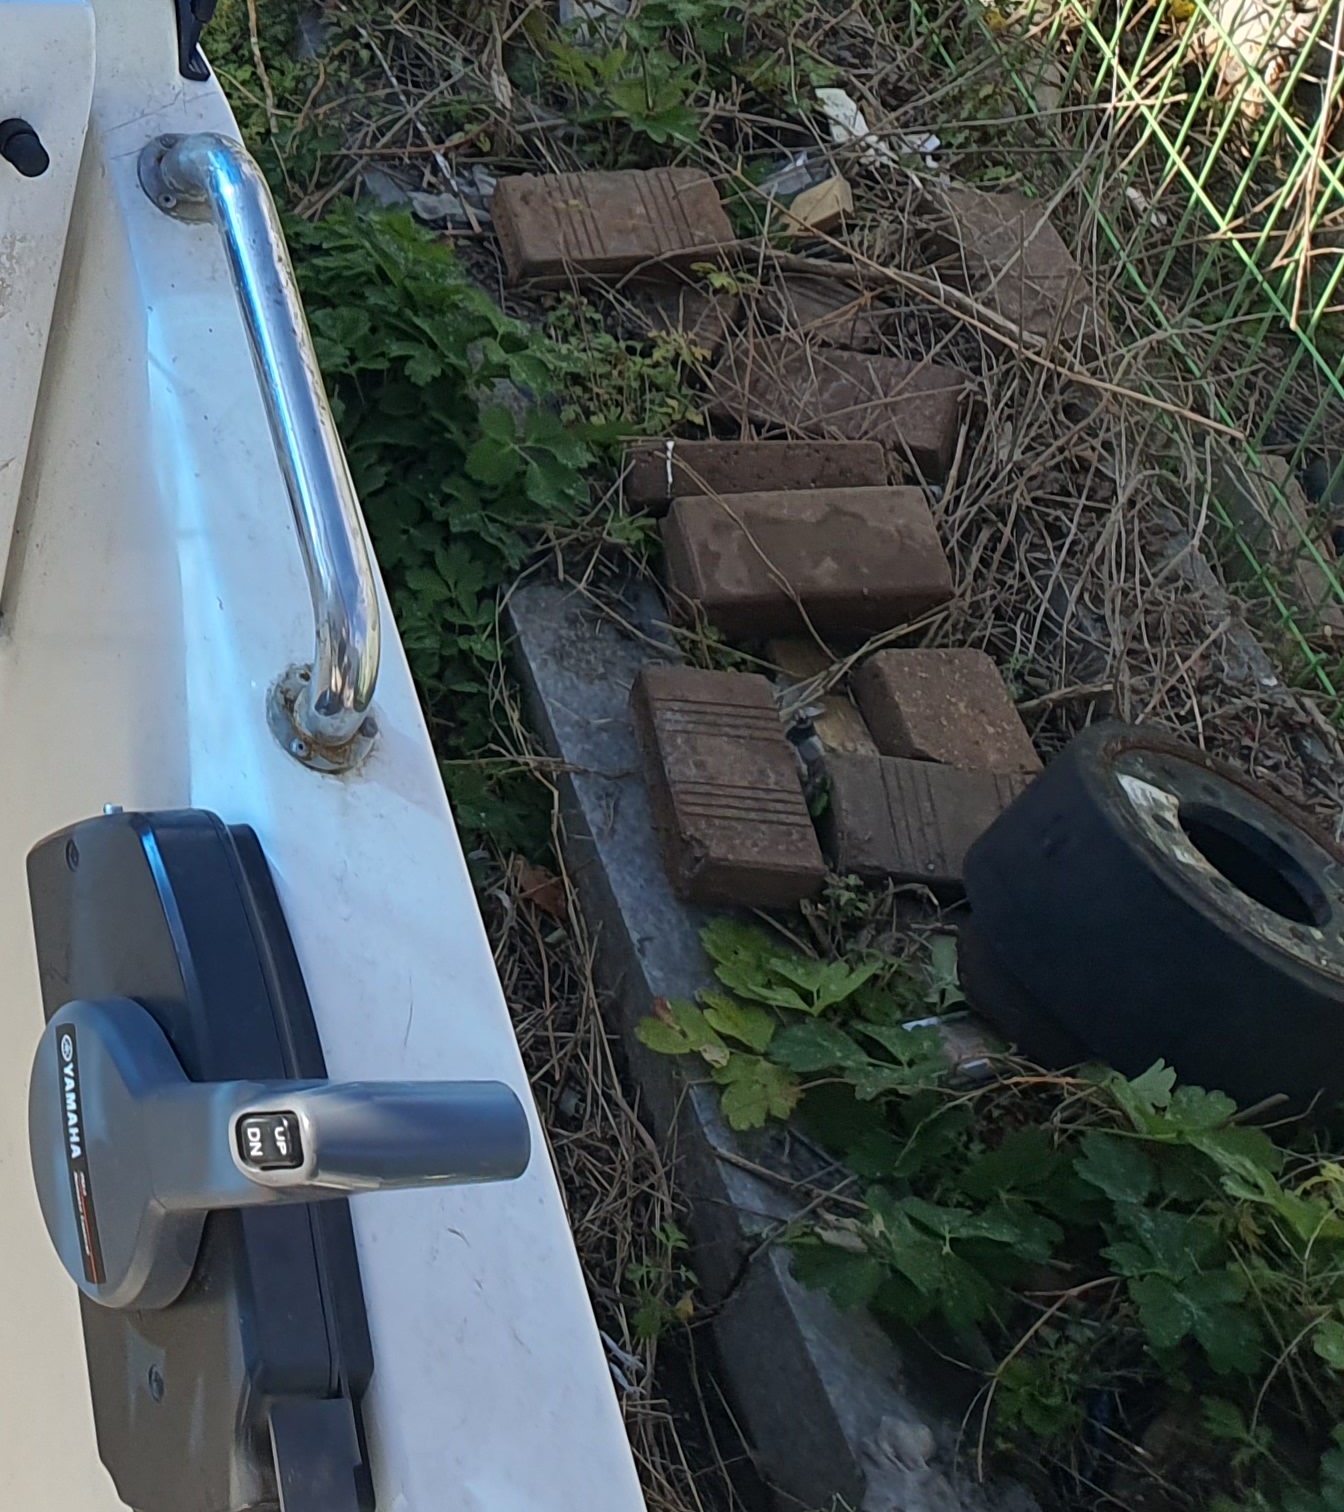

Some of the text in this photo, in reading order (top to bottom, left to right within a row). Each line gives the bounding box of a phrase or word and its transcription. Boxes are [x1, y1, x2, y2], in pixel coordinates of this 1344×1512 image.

[63, 1061, 82, 1160] YAMAHA
[246, 1126, 264, 1157] DN
[273, 1125, 288, 1156] UP
